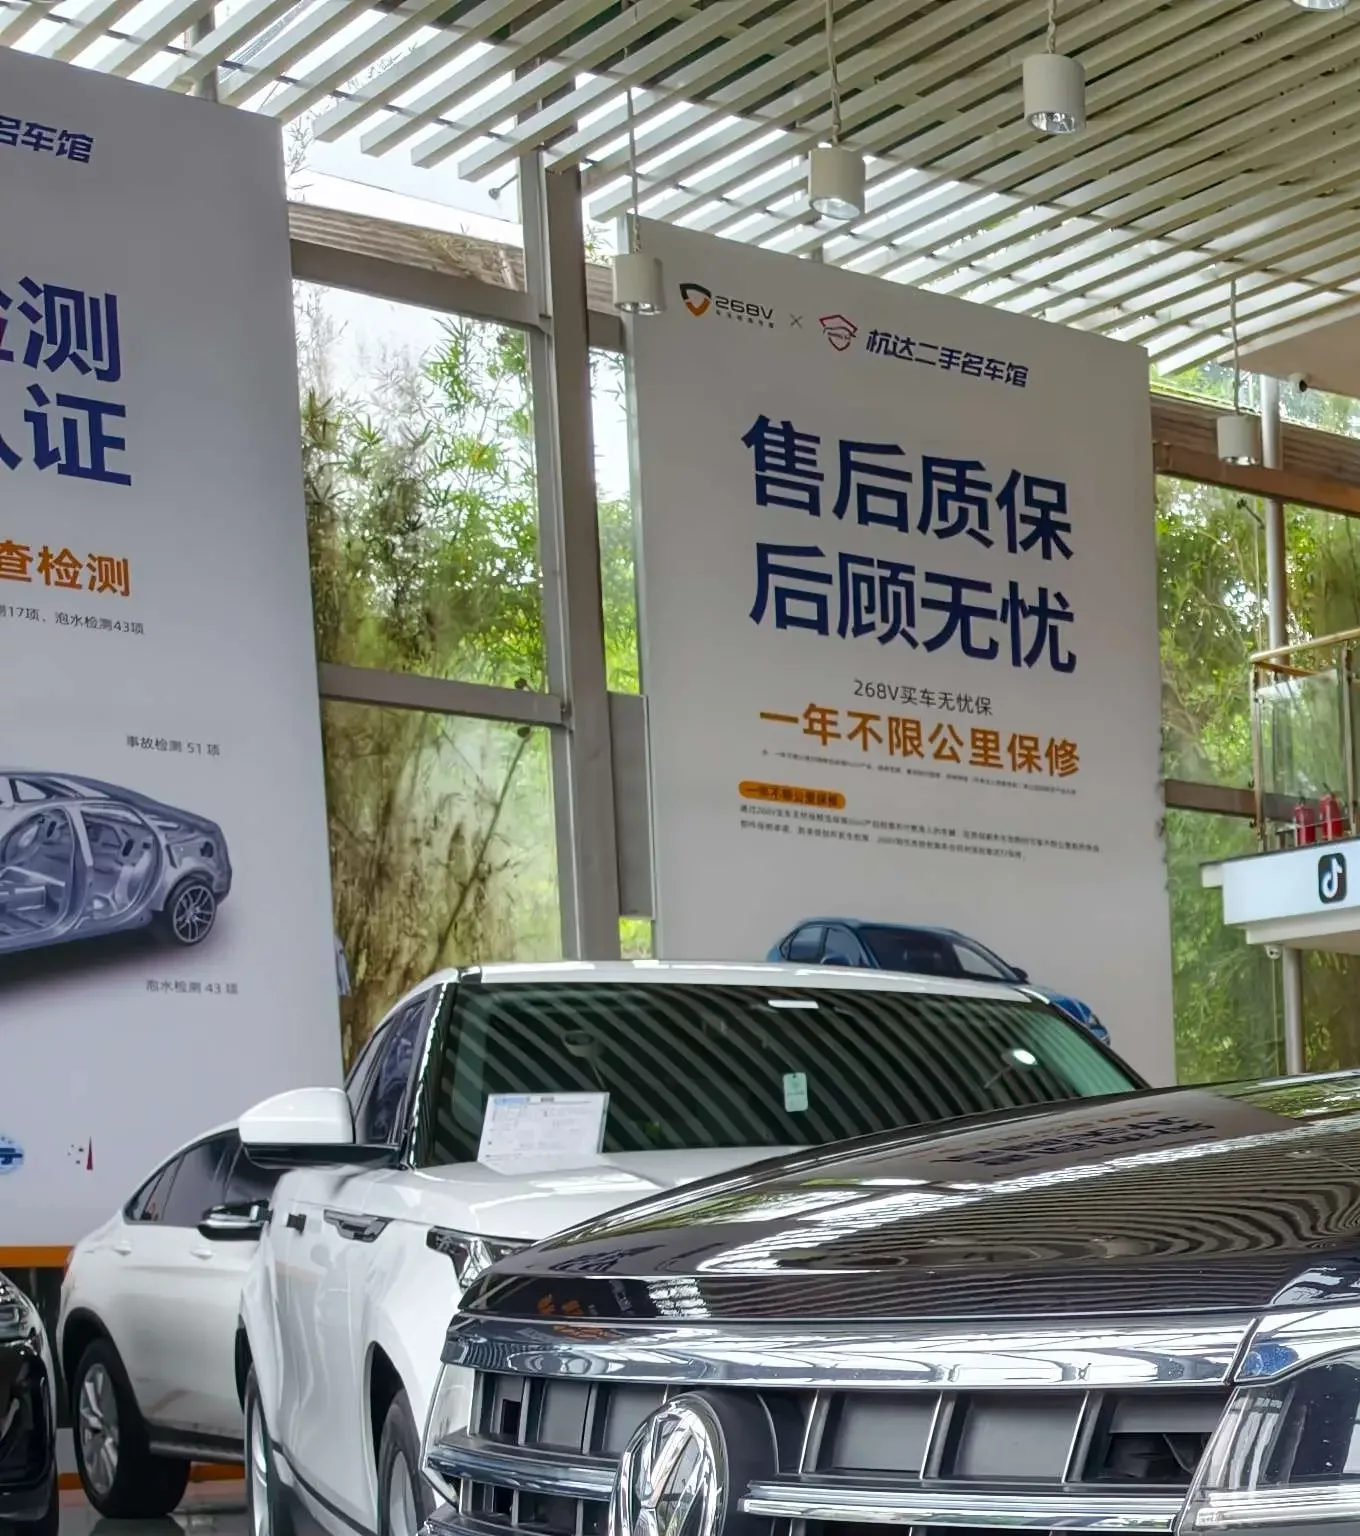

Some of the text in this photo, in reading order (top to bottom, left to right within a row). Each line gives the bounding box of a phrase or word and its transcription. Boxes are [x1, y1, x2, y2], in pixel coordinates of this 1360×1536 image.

[715, 296, 773, 320] 268V
[866, 329, 1029, 388] 杭达二手名车馆
[741, 414, 1074, 561] 售后质保
[749, 542, 1077, 675] 后顾无忧
[853, 680, 994, 716] 268V买车无忧保
[760, 703, 1080, 777] 一年不限公里保修
